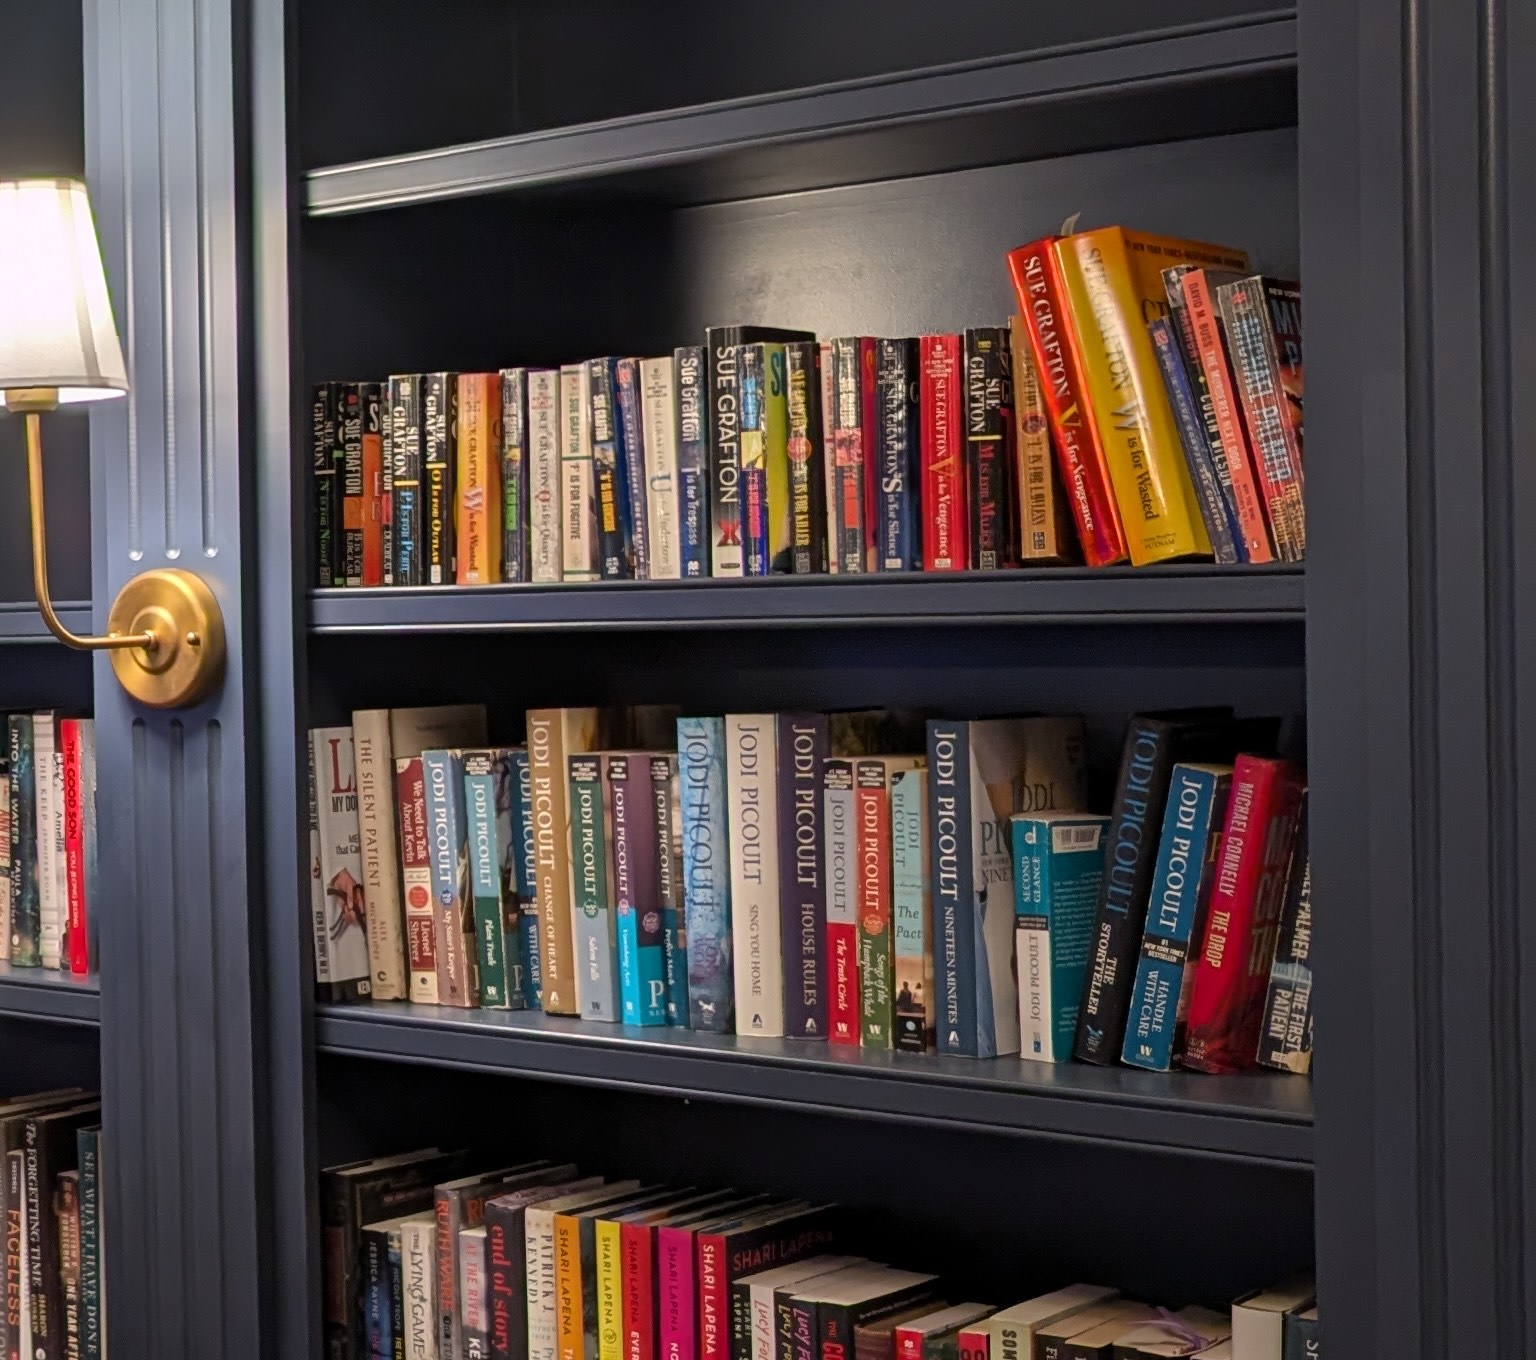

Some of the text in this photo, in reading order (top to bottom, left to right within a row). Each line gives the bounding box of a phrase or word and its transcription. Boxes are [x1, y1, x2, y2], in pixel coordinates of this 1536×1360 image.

[1023, 256, 1070, 397] SUE GRAFTON
[394, 406, 406, 475] GRAFTON
[406, 426, 417, 454] SUE
[426, 396, 436, 461] GRAFTON
[436, 415, 444, 441] SUE
[681, 357, 700, 441] Sue Grafton
[716, 347, 740, 503] SUE GRAFTON
[970, 356, 985, 432] GRAFTON
[986, 378, 1000, 409] SUE
[345, 418, 362, 494] SUE GRAFTON
[1057, 401, 1095, 531] V Vengeance
[1110, 403, 1160, 520] W is for Wasted
[40, 756, 48, 781] THE
[67, 768, 76, 808] GOOD
[360, 738, 380, 888] THE SILENT PATIENT
[428, 761, 452, 884] JODI PICOULT
[737, 724, 762, 883] JODI PICOULT
[792, 724, 817, 888] JODI PICOULT
[935, 729, 957, 900] JODI PICOULT
[68, 811, 77, 839] SON
[472, 783, 492, 886] JODI PICOULT
[535, 777, 555, 870] PICOULT
[579, 787, 596, 895] JODI PICOULT
[614, 785, 628, 895] JODI PICOULT
[655, 788, 670, 897] JODI PICOULT
[830, 797, 846, 912] JODI PICOULT
[862, 794, 879, 910] JODI PICOULT
[1106, 728, 1160, 919] JODI PICOULT
[1158, 776, 1202, 932] JODI PICOULT
[801, 904, 816, 1005] HOUSE RULES
[898, 906, 918, 919] The
[945, 907, 958, 1023] NINETEEN MINUTES
[7, 1209, 20, 1325] FACELESS
[27, 1149, 42, 1286] FORGETTING TIME
[84, 1152, 97, 1353] SEE WHAT HAVE DONE
[66, 1278, 77, 1301] ONE
[67, 1304, 77, 1332] YEAR
[559, 1228, 572, 1335] SHARI LAPENA
[602, 1236, 614, 1325] SHARI LAPENA
[703, 1244, 716, 1354] SHARI LAPENA
